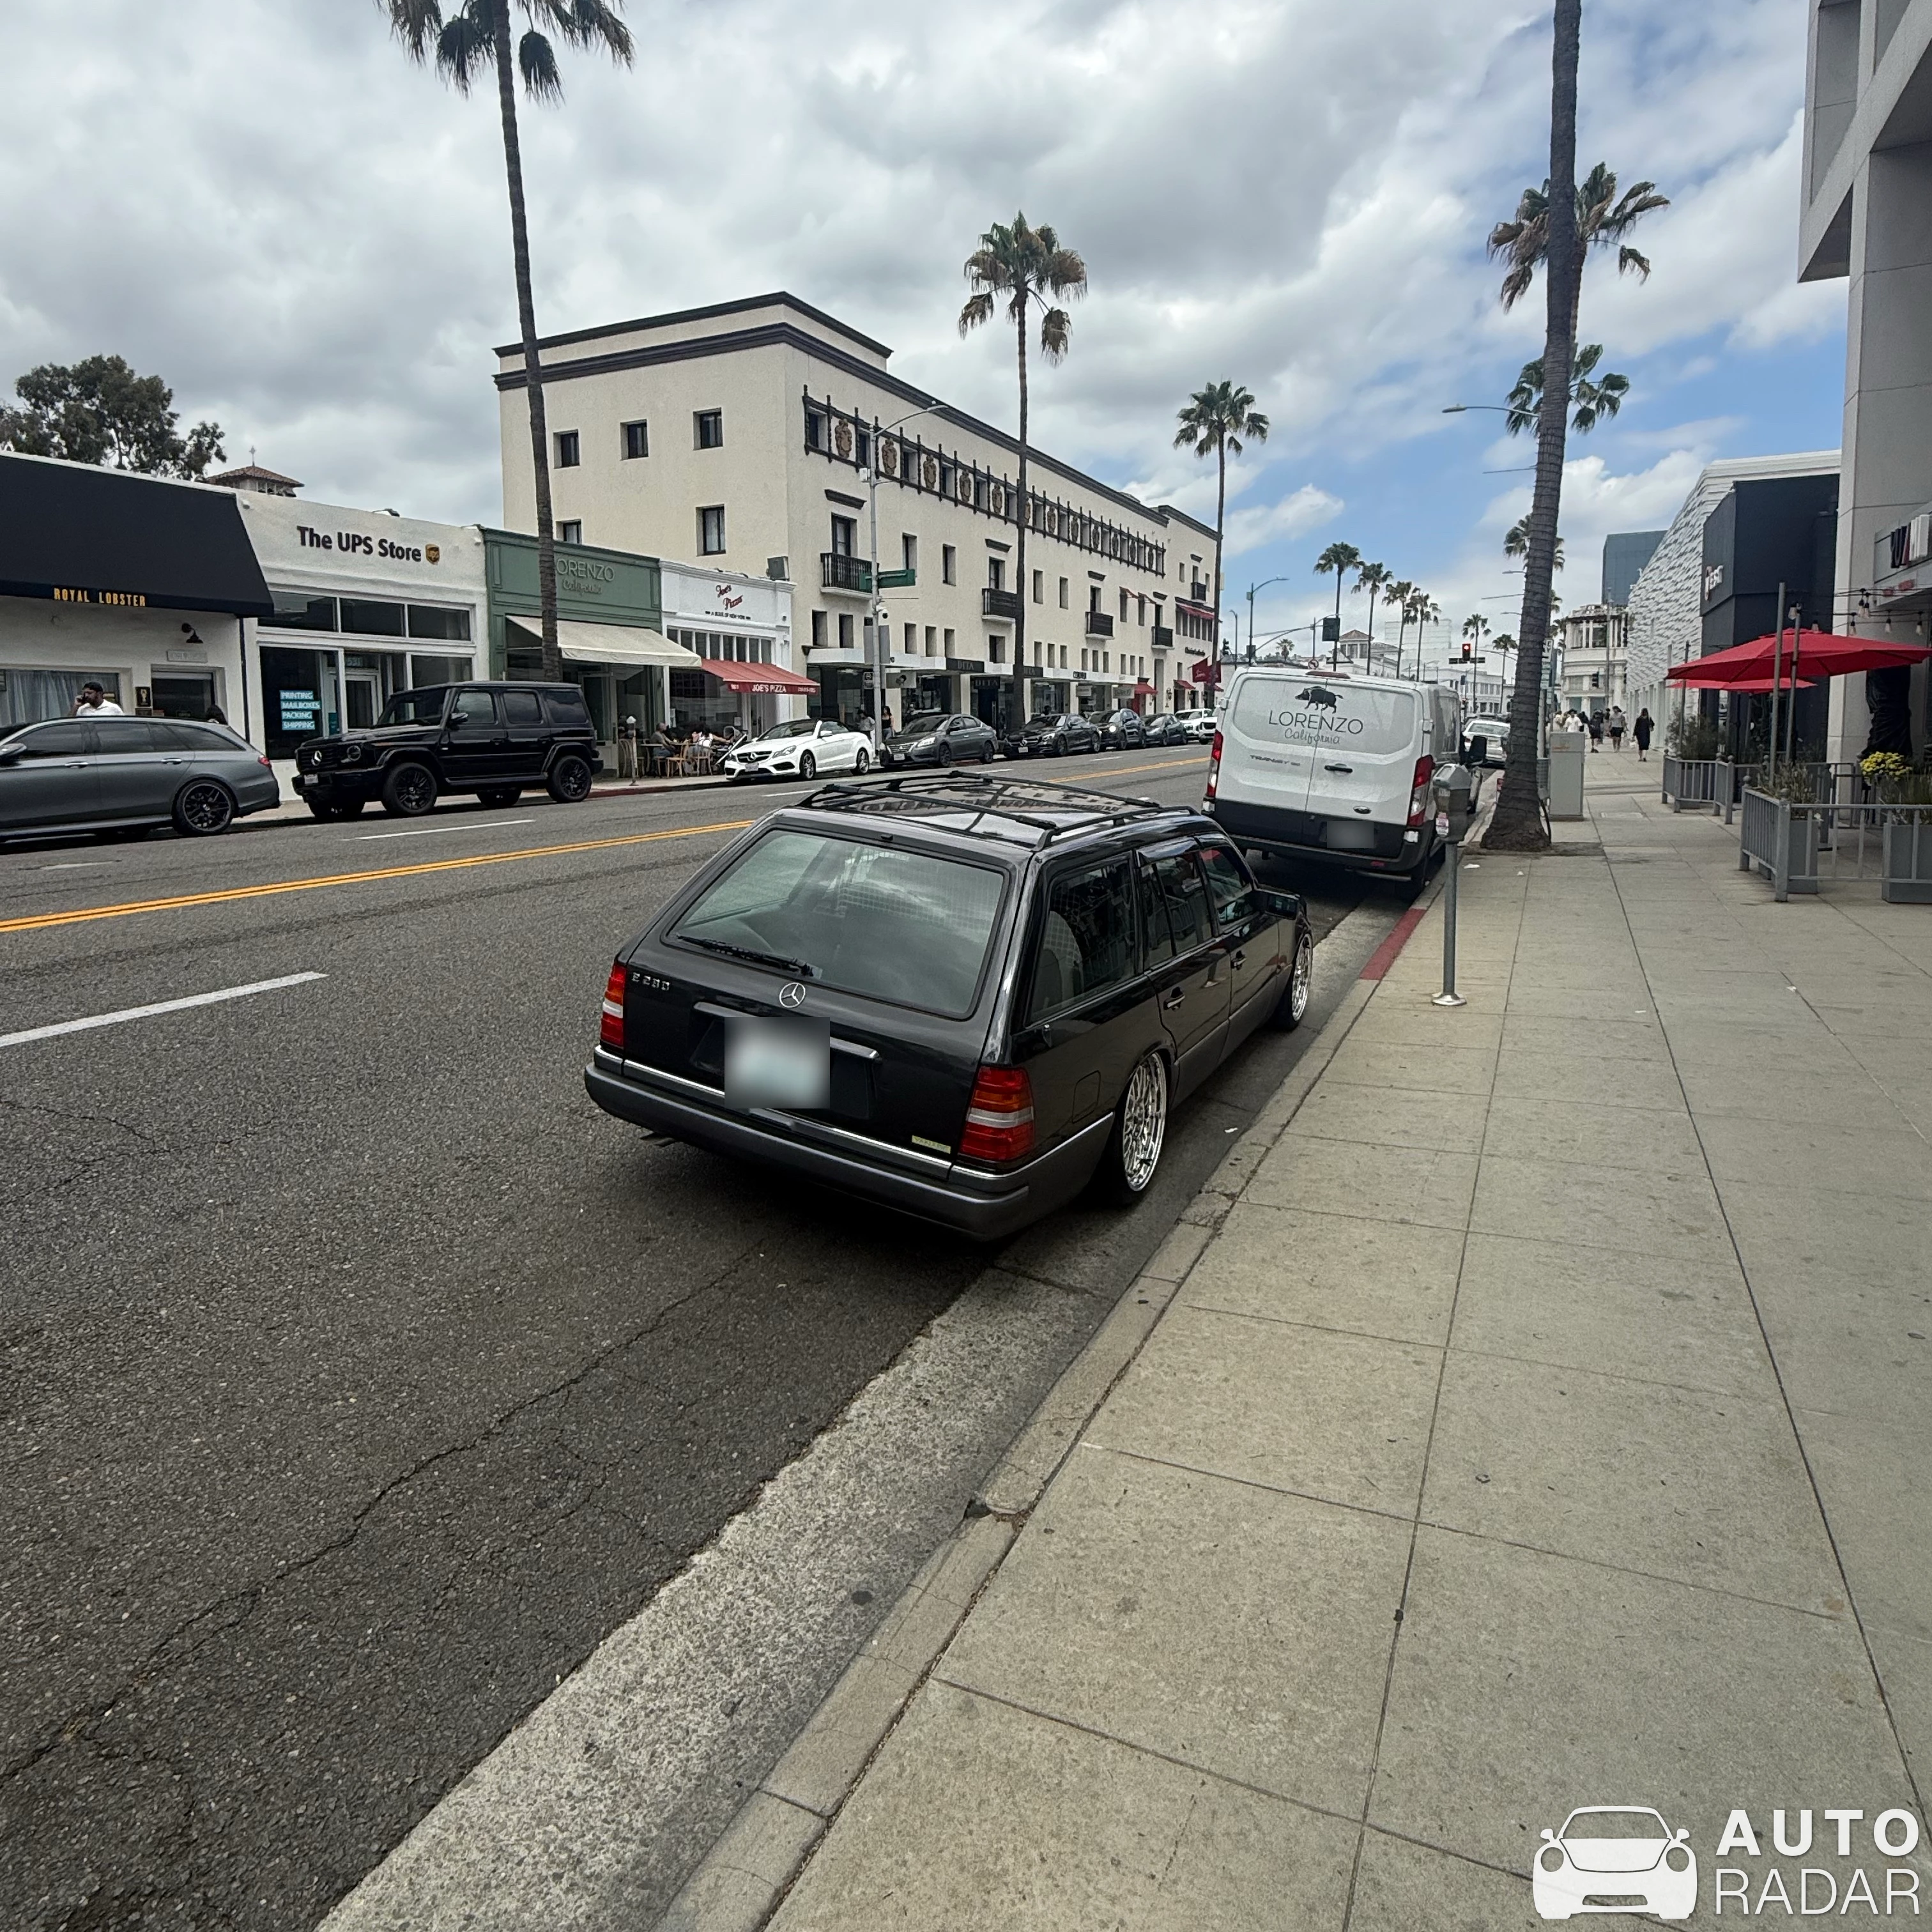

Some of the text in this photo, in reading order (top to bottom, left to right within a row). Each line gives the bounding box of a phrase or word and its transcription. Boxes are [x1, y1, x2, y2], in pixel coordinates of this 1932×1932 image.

[296, 526, 422, 562] The UPS Store
[556, 558, 615, 581] ORENZO
[54, 587, 146, 607] ROYAL LOBSTER
[958, 661, 974, 671] DITA
[752, 684, 769, 693] JOE'S
[770, 684, 787, 693] PIZZA
[1269, 710, 1363, 735] LORENZO
[1284, 728, 1340, 745] California
[632, 972, 641, 983] E
